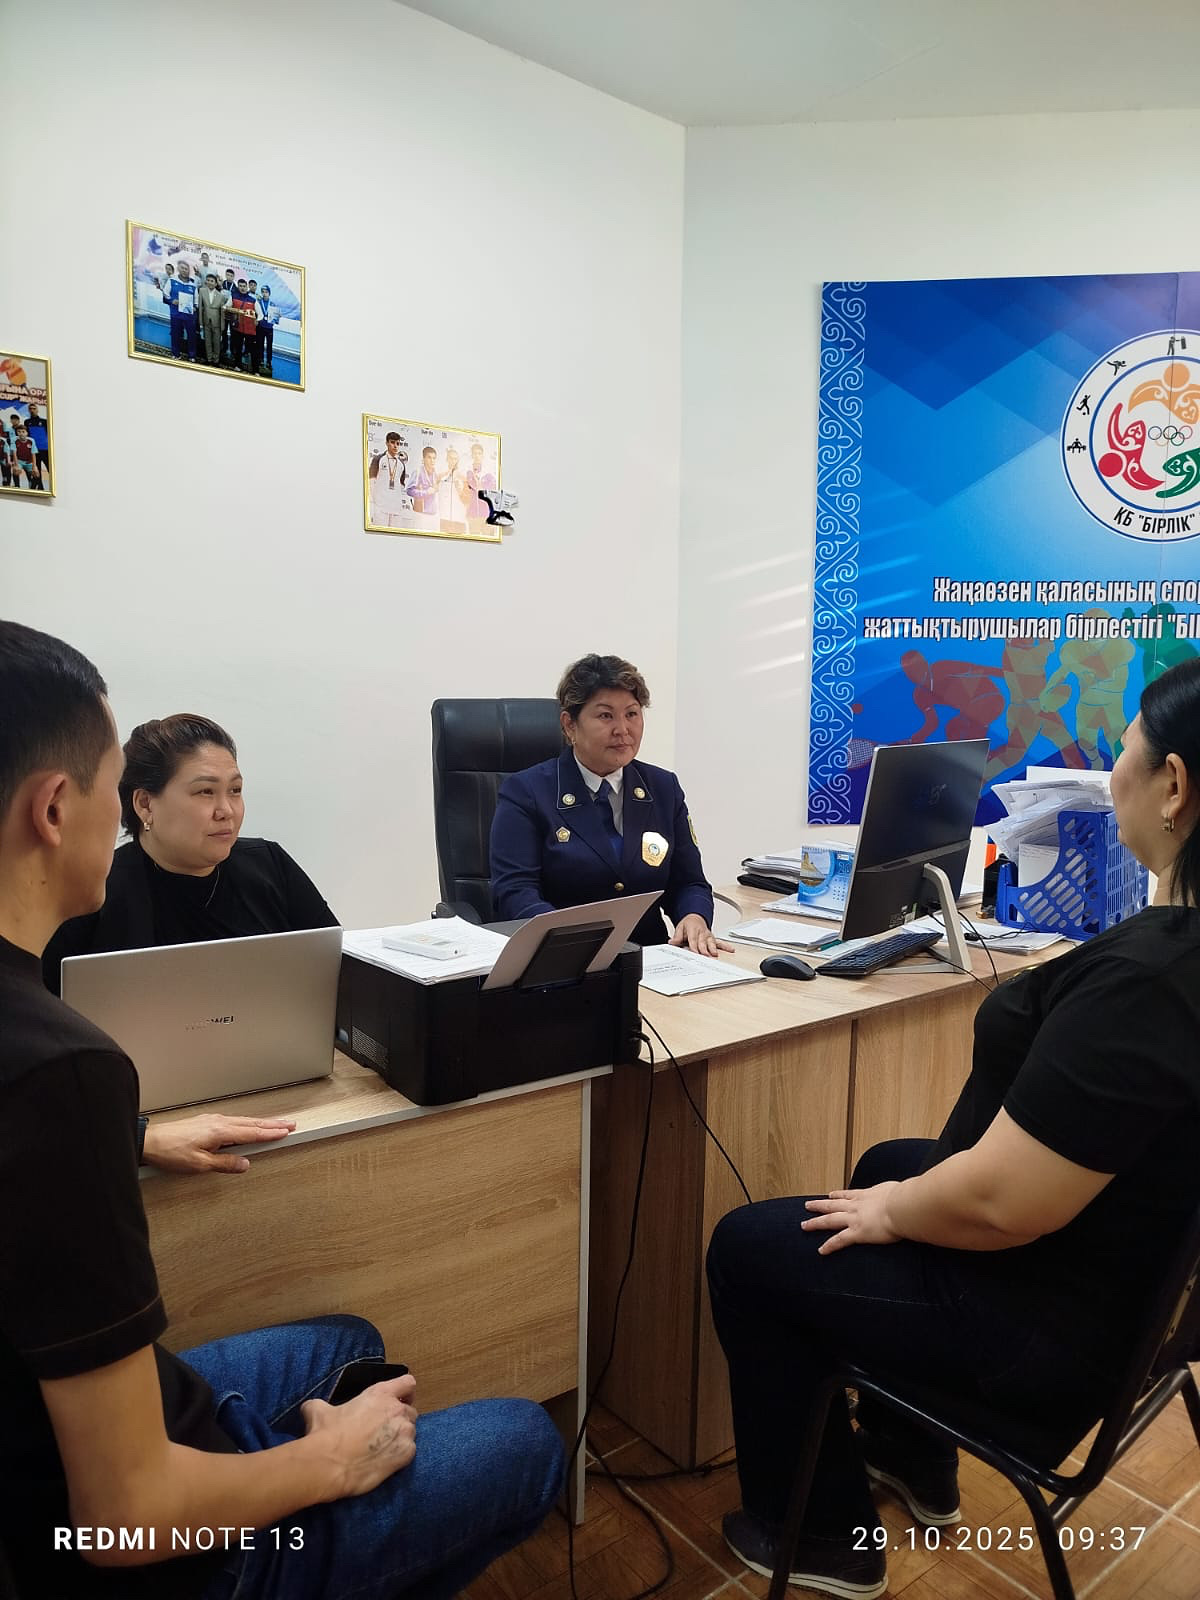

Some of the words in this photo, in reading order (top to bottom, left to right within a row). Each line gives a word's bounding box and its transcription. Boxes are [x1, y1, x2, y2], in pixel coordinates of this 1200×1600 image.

[1138, 513, 1195, 534] "БІРЛІК"
[933, 577, 1032, 606] Жаңаөзен
[1036, 580, 1156, 606] қаласының
[1160, 580, 1200, 605] спо
[863, 617, 1061, 641] жаттықтырушылар
[1065, 613, 1163, 641] бірлестігі
